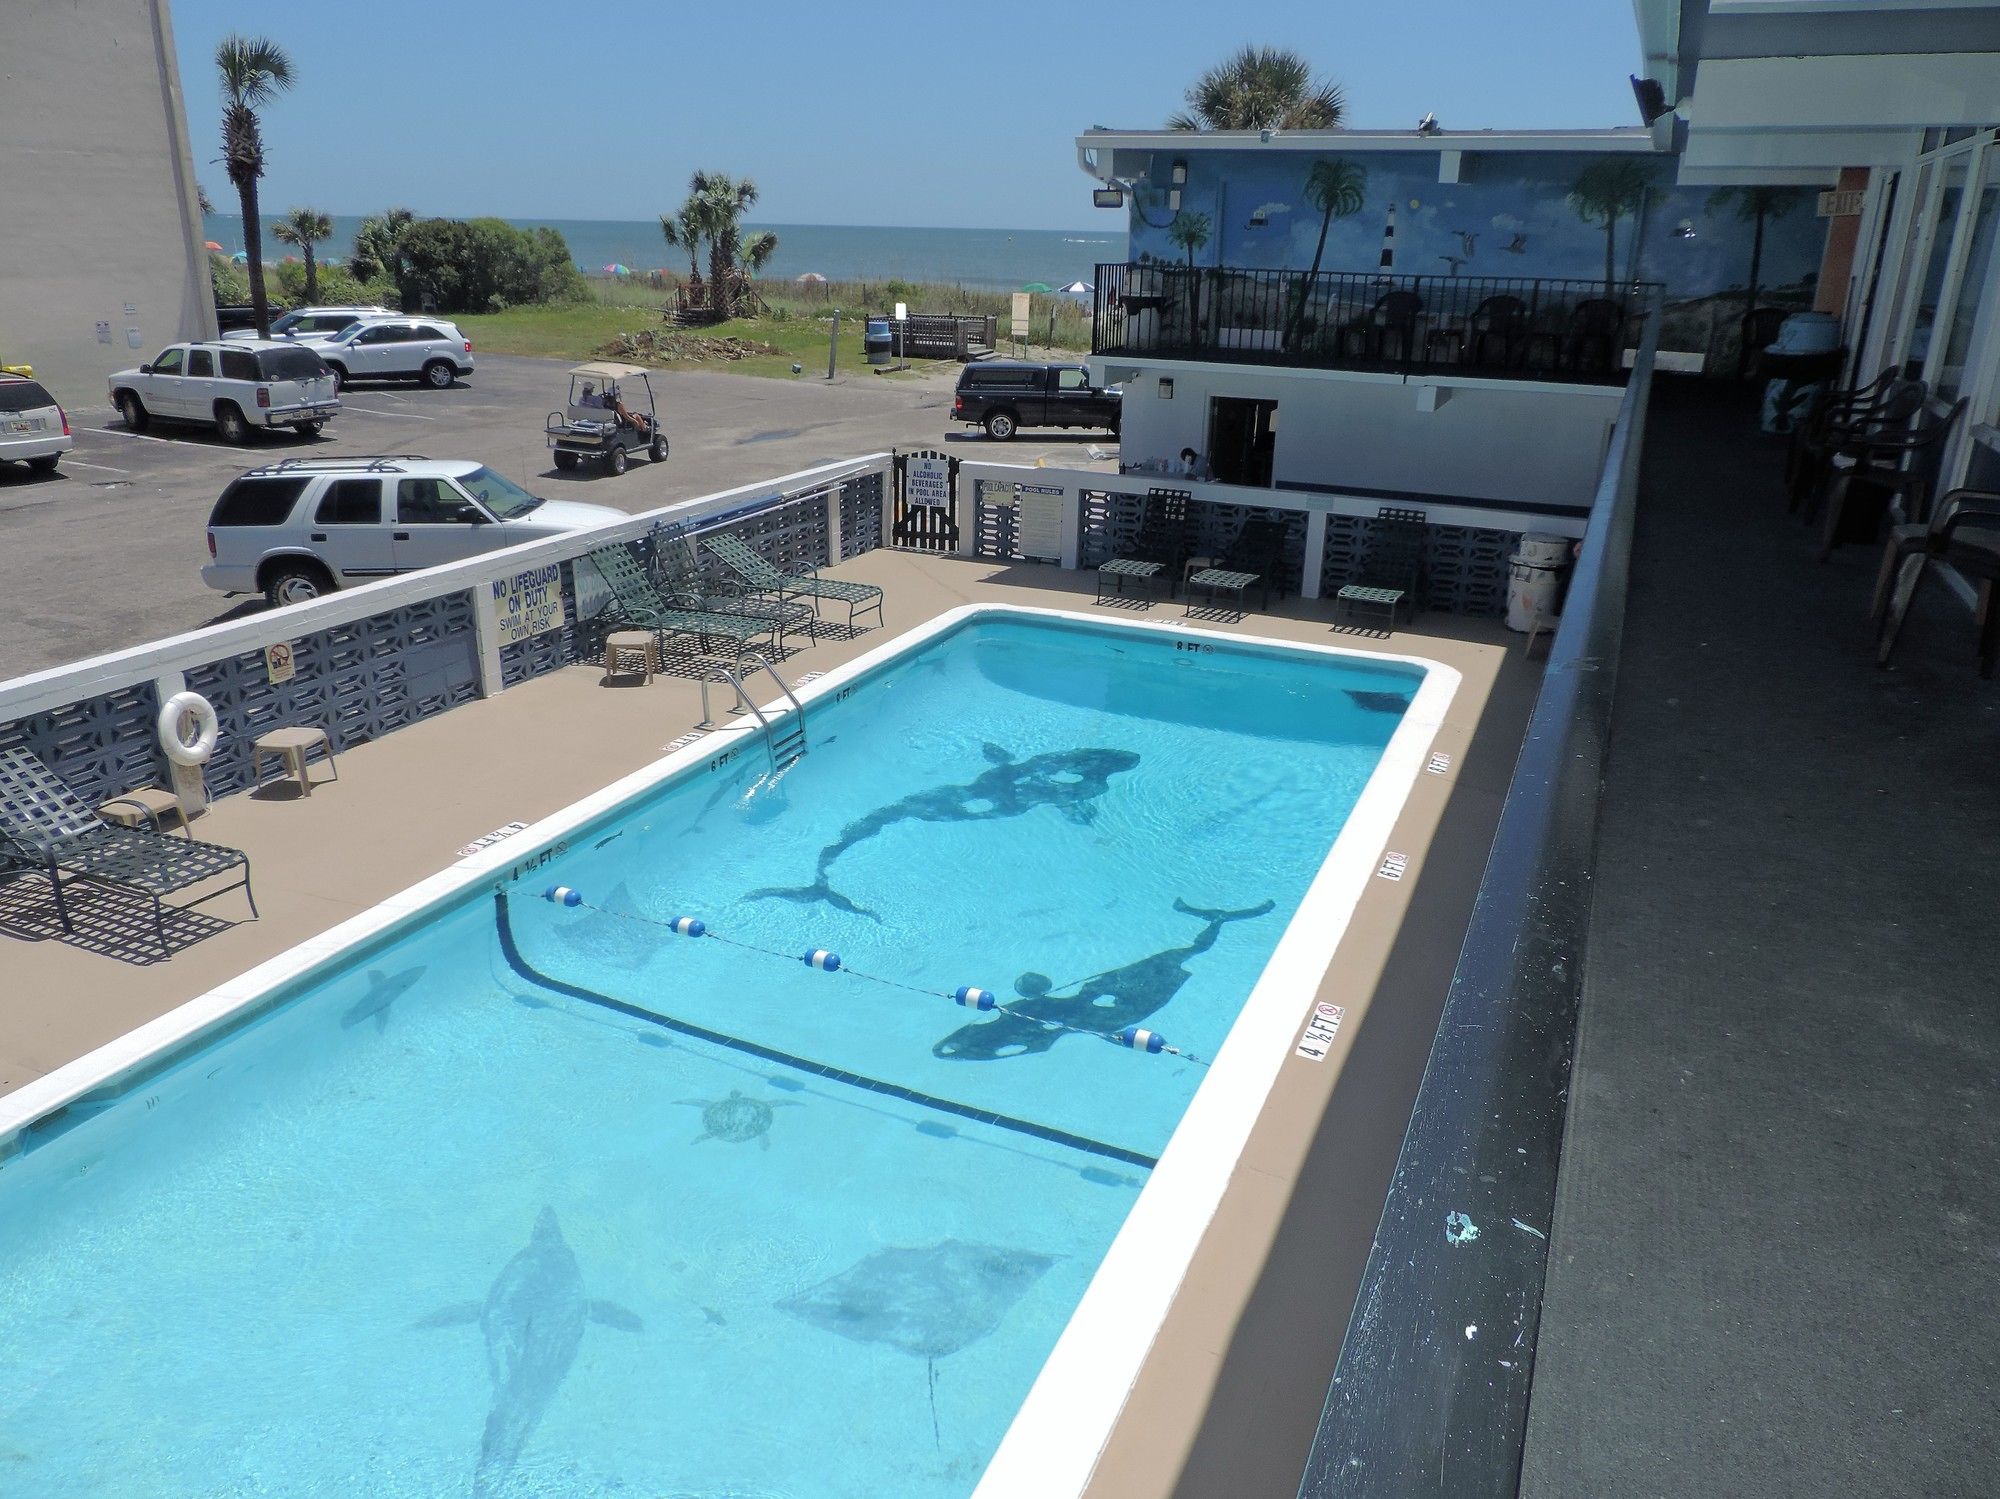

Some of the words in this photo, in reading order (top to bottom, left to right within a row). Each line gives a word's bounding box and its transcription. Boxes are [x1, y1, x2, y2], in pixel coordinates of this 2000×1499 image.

[923, 462, 932, 470] NO
[912, 470, 943, 480] ALCOHOLIC
[911, 479, 944, 489] BEVERAGES
[916, 489, 930, 497] POOL
[931, 490, 947, 498] AREA
[914, 497, 941, 506] ALLOWED
[492, 579, 507, 600] NO
[510, 564, 559, 594] LIFEGUARD
[508, 594, 522, 614] ON
[524, 585, 549, 609] DUTY
[500, 614, 522, 631] SWIM
[524, 609, 534, 623] AT
[537, 601, 559, 619] YOUR
[511, 622, 530, 640] OWN
[532, 616, 551, 633] RISK
[1176, 640, 1183, 651] 8
[1187, 642, 1200, 653] FT
[719, 753, 729, 768] FT
[539, 848, 552, 867] FT
[1382, 859, 1405, 873] FT
[1310, 1014, 1338, 1034] FT
[1298, 1045, 1325, 1057] 4
